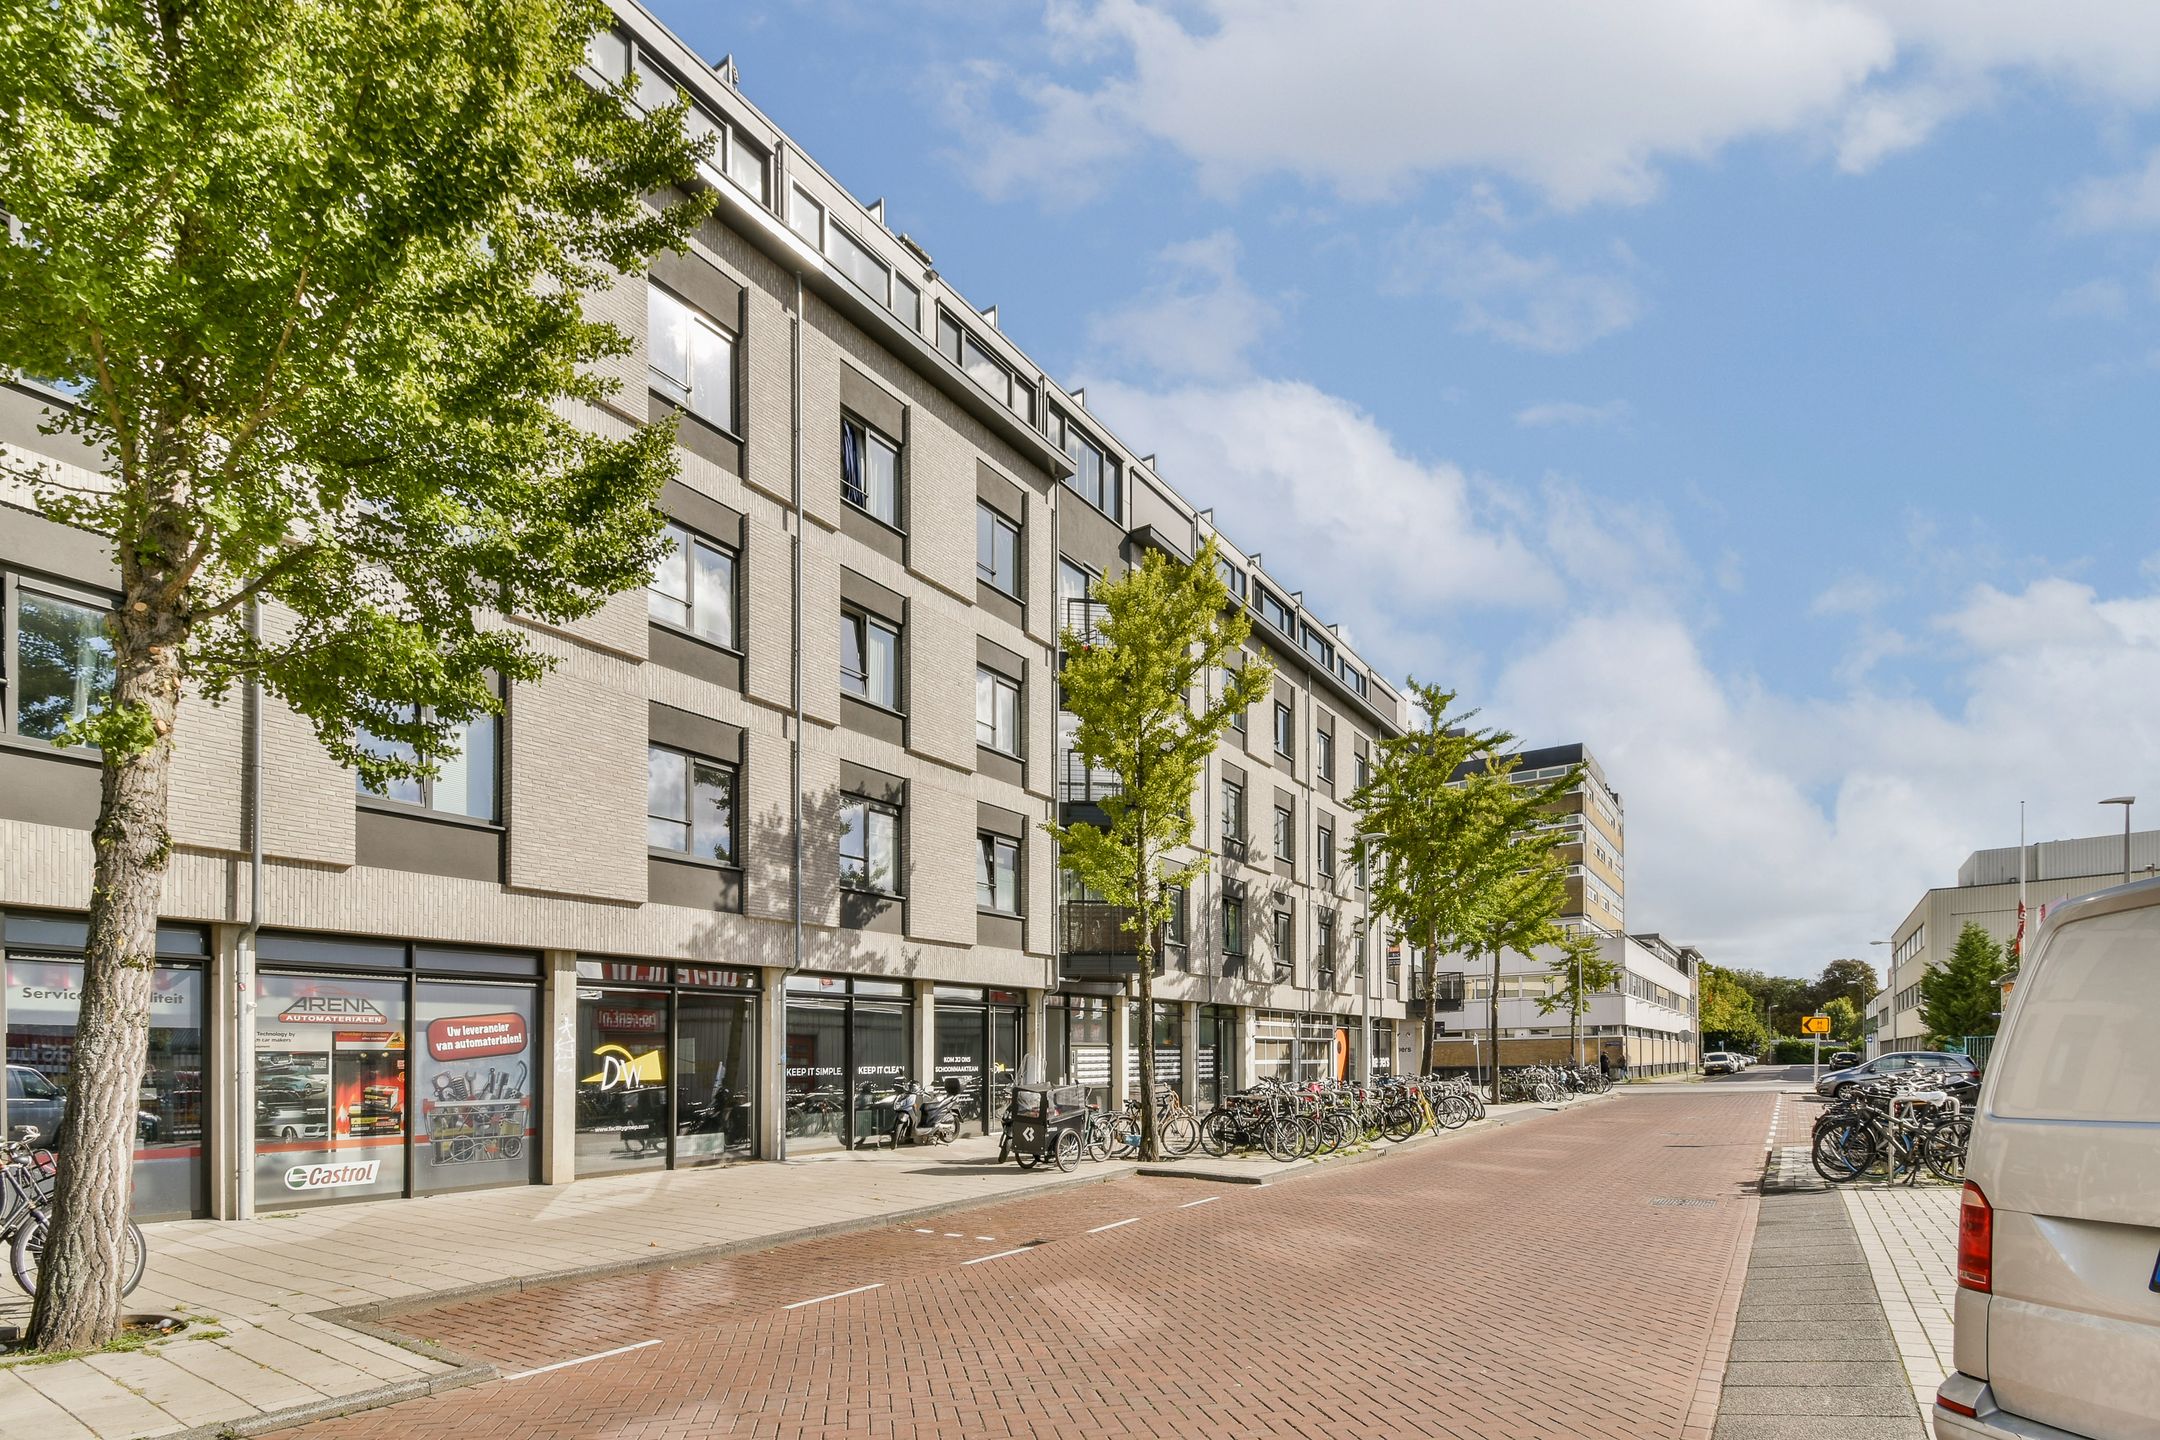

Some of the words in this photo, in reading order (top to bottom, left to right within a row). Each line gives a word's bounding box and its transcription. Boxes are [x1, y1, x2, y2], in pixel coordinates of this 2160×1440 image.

[150, 992, 184, 1004] liteit
[281, 996, 383, 1015] ARENA
[286, 1015, 381, 1024] AUTOMATERIALEN
[447, 1026, 462, 1037] Uw
[462, 1023, 509, 1035] leverancier
[436, 1041, 454, 1052] van
[455, 1033, 522, 1049] automaterialen!
[786, 1067, 806, 1076] KEEP
[807, 1067, 815, 1076] IT
[815, 1067, 843, 1076] SIMPLE,
[858, 1066, 876, 1075] KEEP
[876, 1066, 883, 1075] IT
[308, 1164, 373, 1186] Castrol
